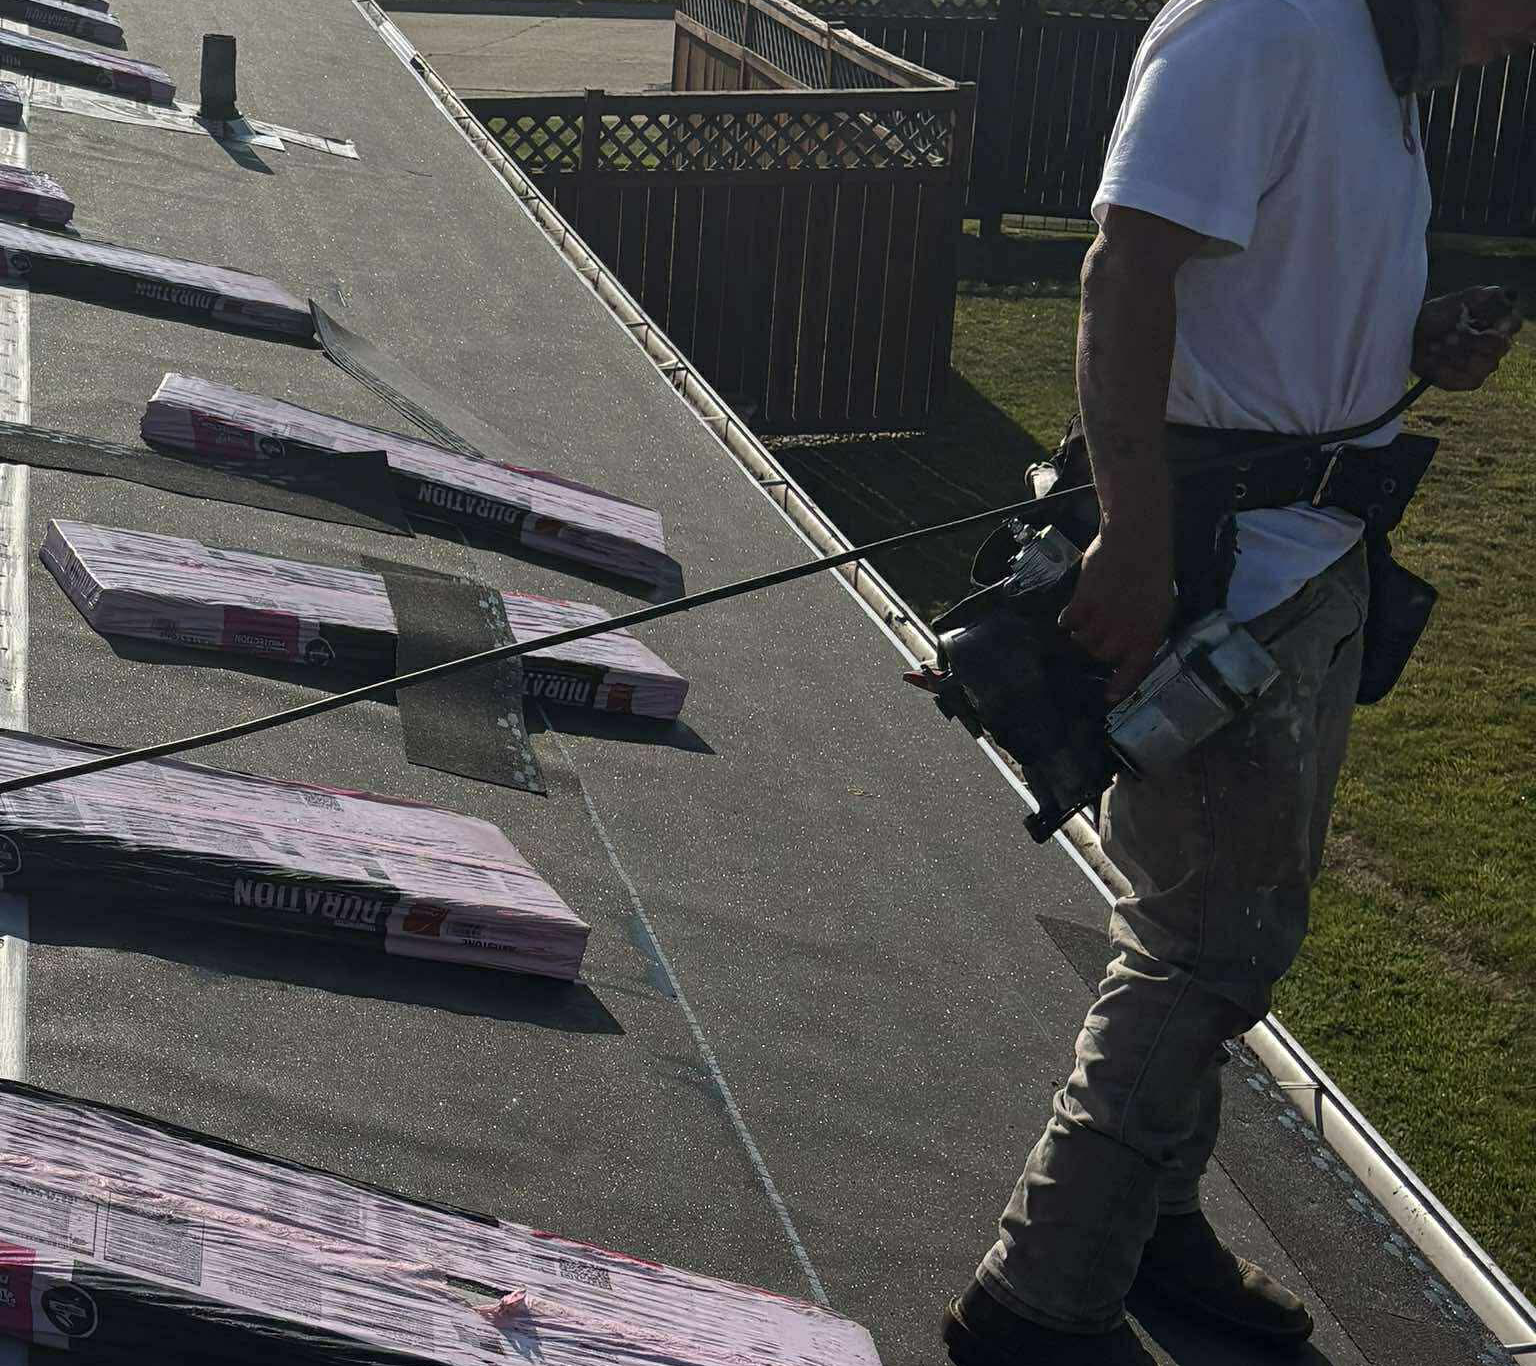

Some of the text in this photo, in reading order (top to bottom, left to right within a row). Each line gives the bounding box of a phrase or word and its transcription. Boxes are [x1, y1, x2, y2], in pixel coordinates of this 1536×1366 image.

[418, 480, 521, 524] DURATION
[521, 673, 591, 704] DURAT
[234, 878, 384, 925] DURATION
